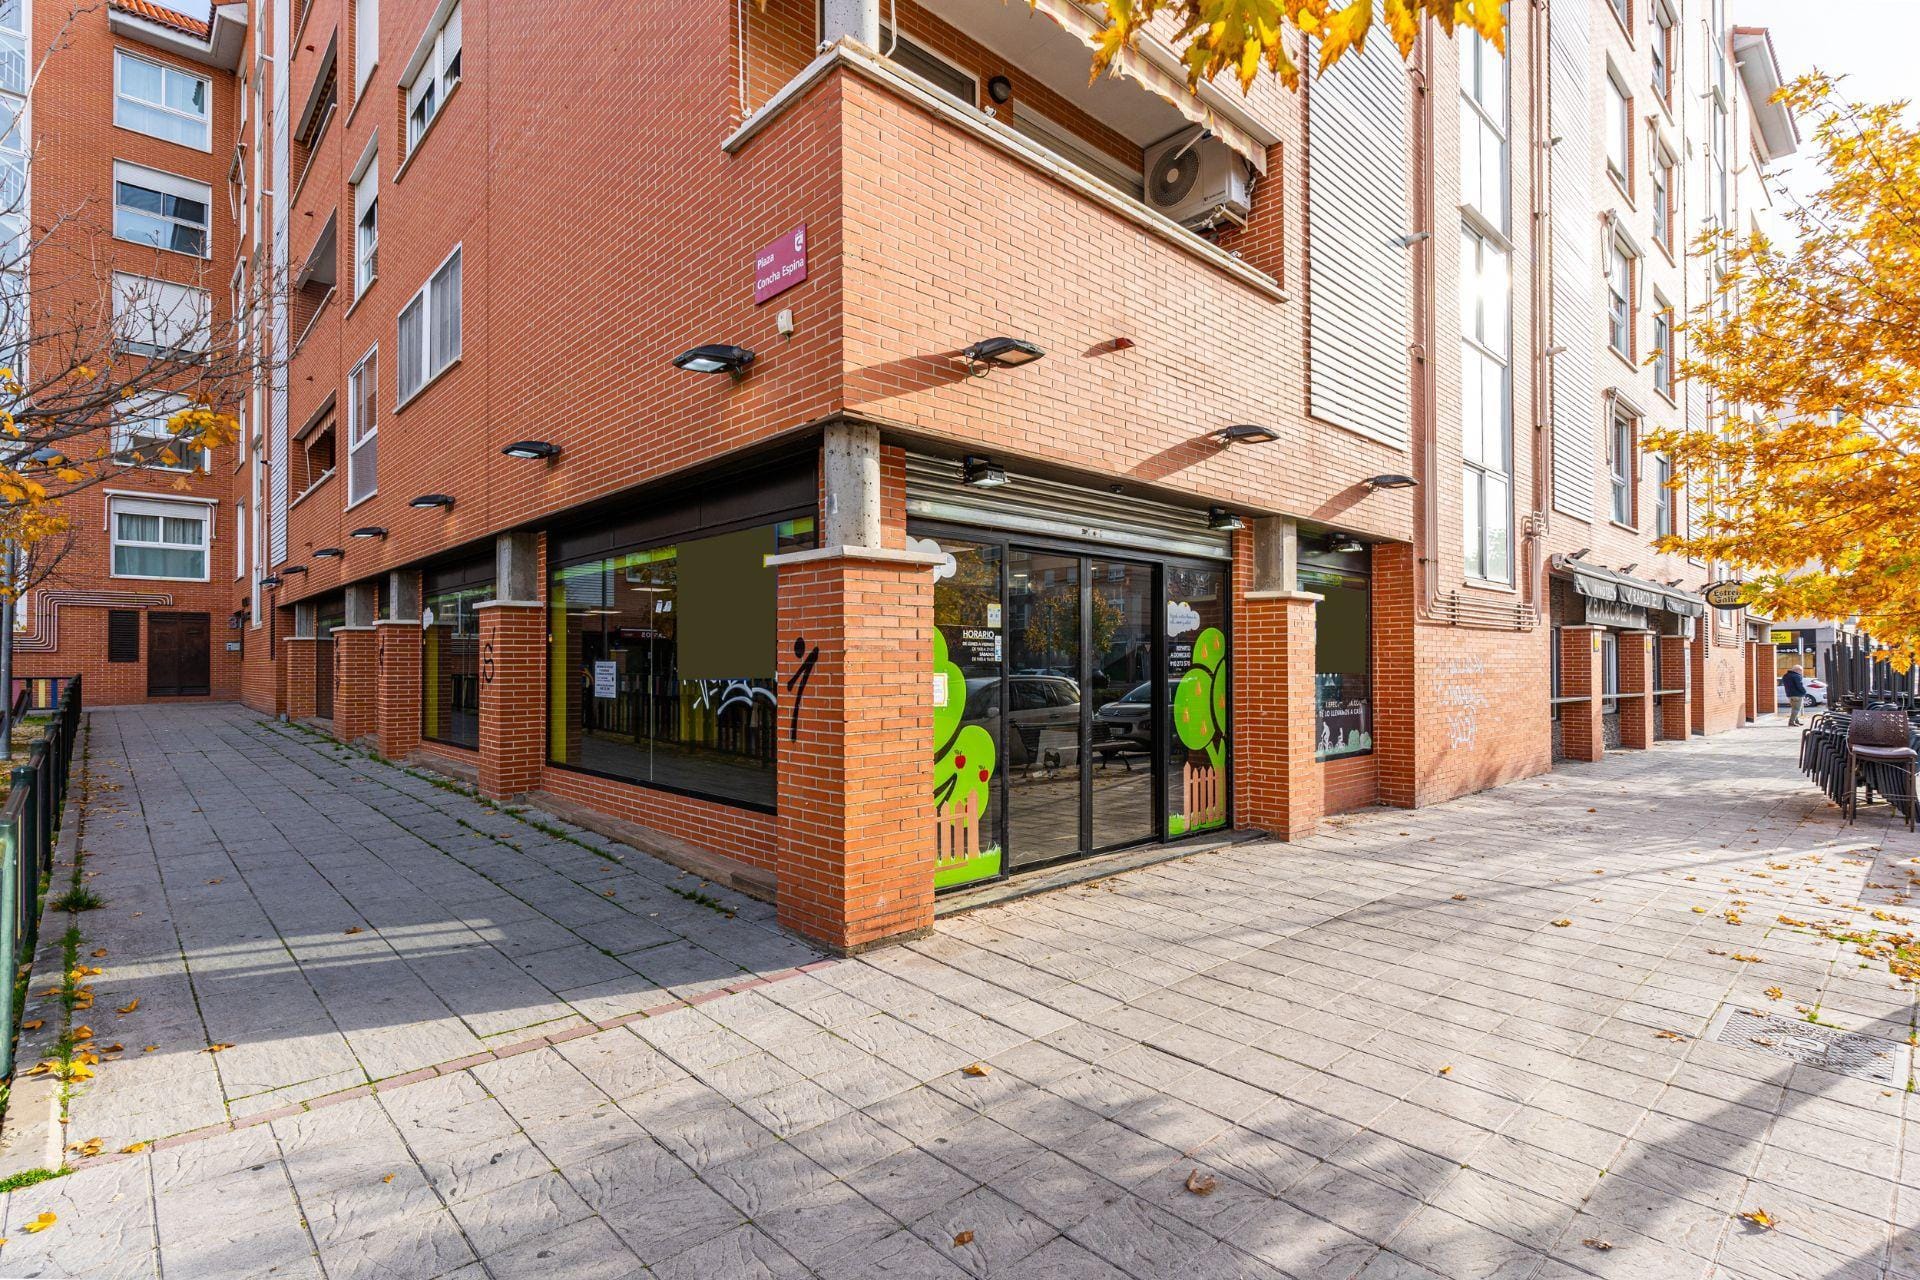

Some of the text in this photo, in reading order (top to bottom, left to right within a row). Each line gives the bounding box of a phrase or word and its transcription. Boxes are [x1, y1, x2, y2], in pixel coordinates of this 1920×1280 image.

[757, 253, 775, 270] Plaza
[757, 257, 804, 290] Concha Espina
[962, 629, 995, 639] HORARIO
